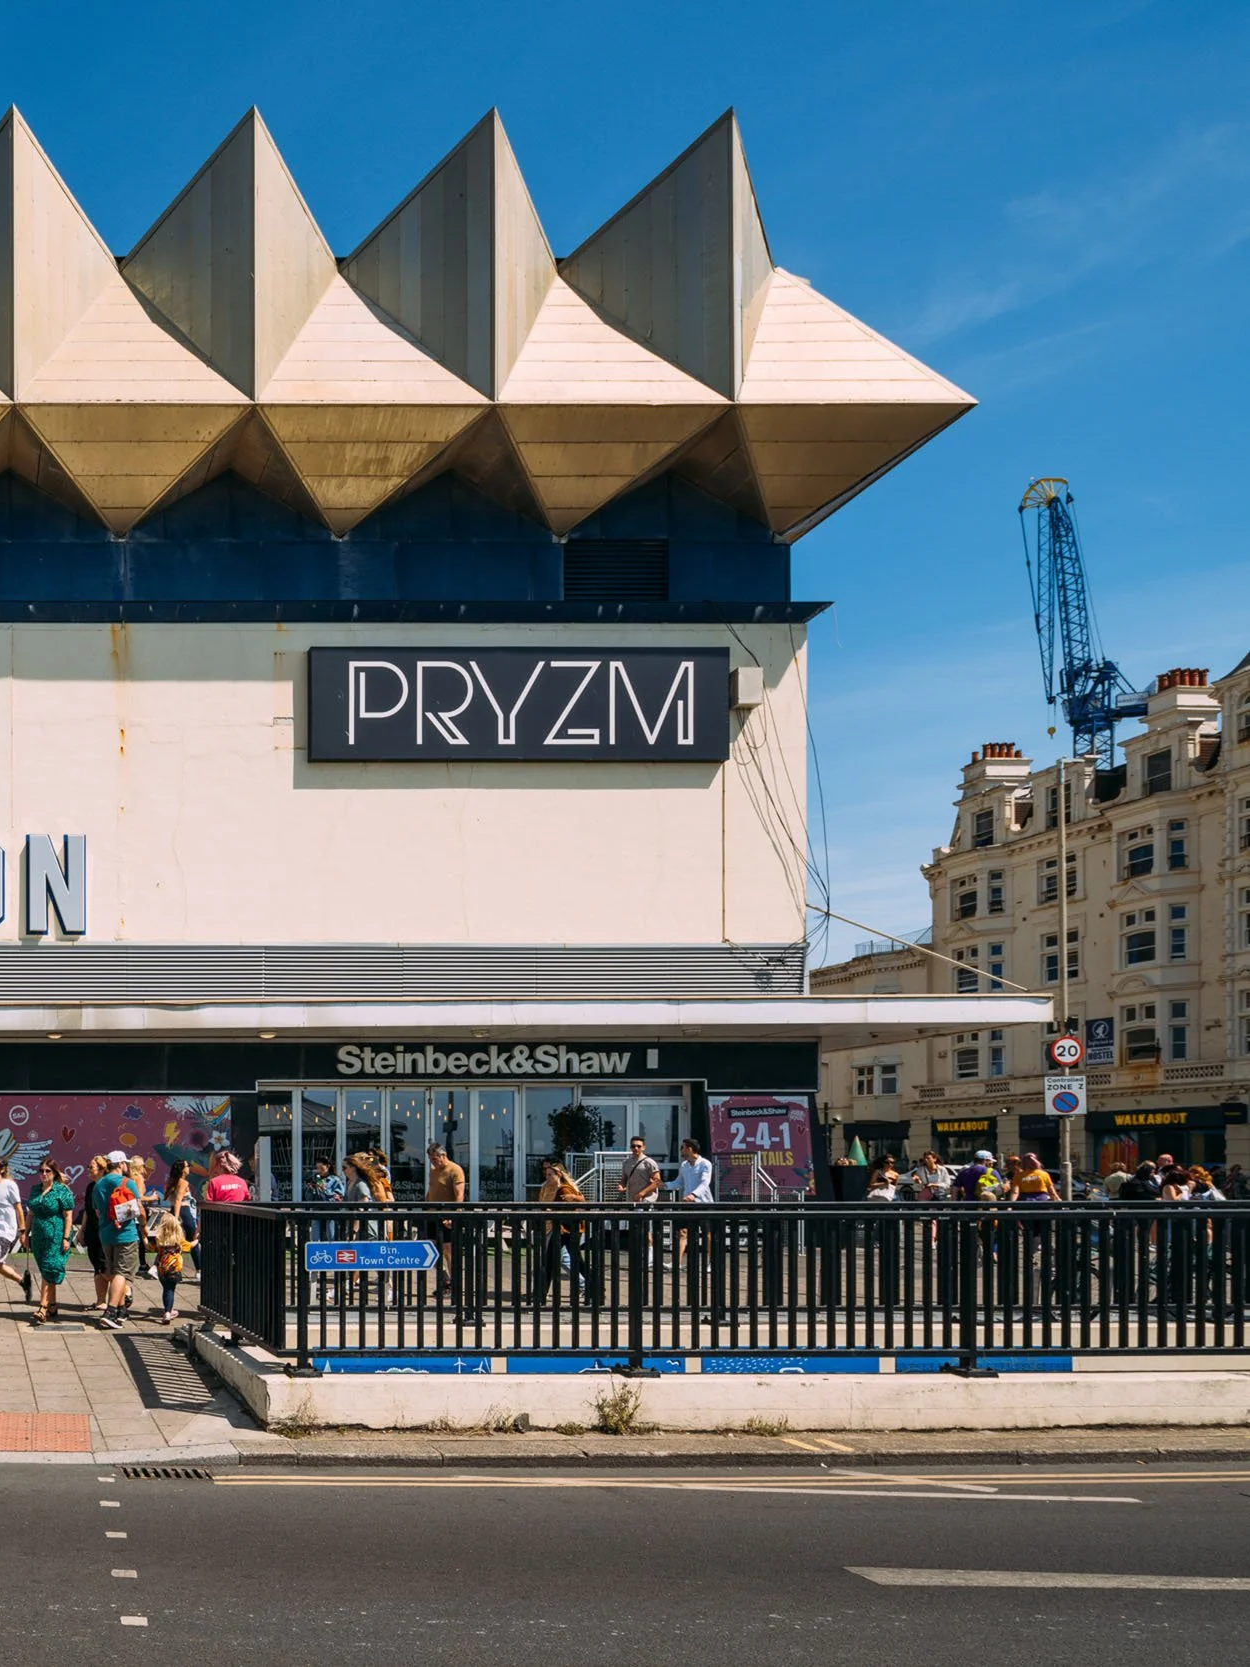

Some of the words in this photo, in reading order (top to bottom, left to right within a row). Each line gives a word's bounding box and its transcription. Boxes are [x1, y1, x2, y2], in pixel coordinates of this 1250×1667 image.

[349, 661, 695, 745] PRYZM
[1056, 1045, 1078, 1057] 20
[336, 1045, 631, 1075] Steinbeck&Shaw
[730, 1107, 787, 1117] Steinbeck&Shaw
[1115, 1112, 1188, 1126] WALKABOUT
[936, 1120, 990, 1132] WALKABOUT
[730, 1122, 792, 1149] 2-4-1
[359, 1256, 384, 1265] Town
[387, 1255, 421, 1265] Centre
